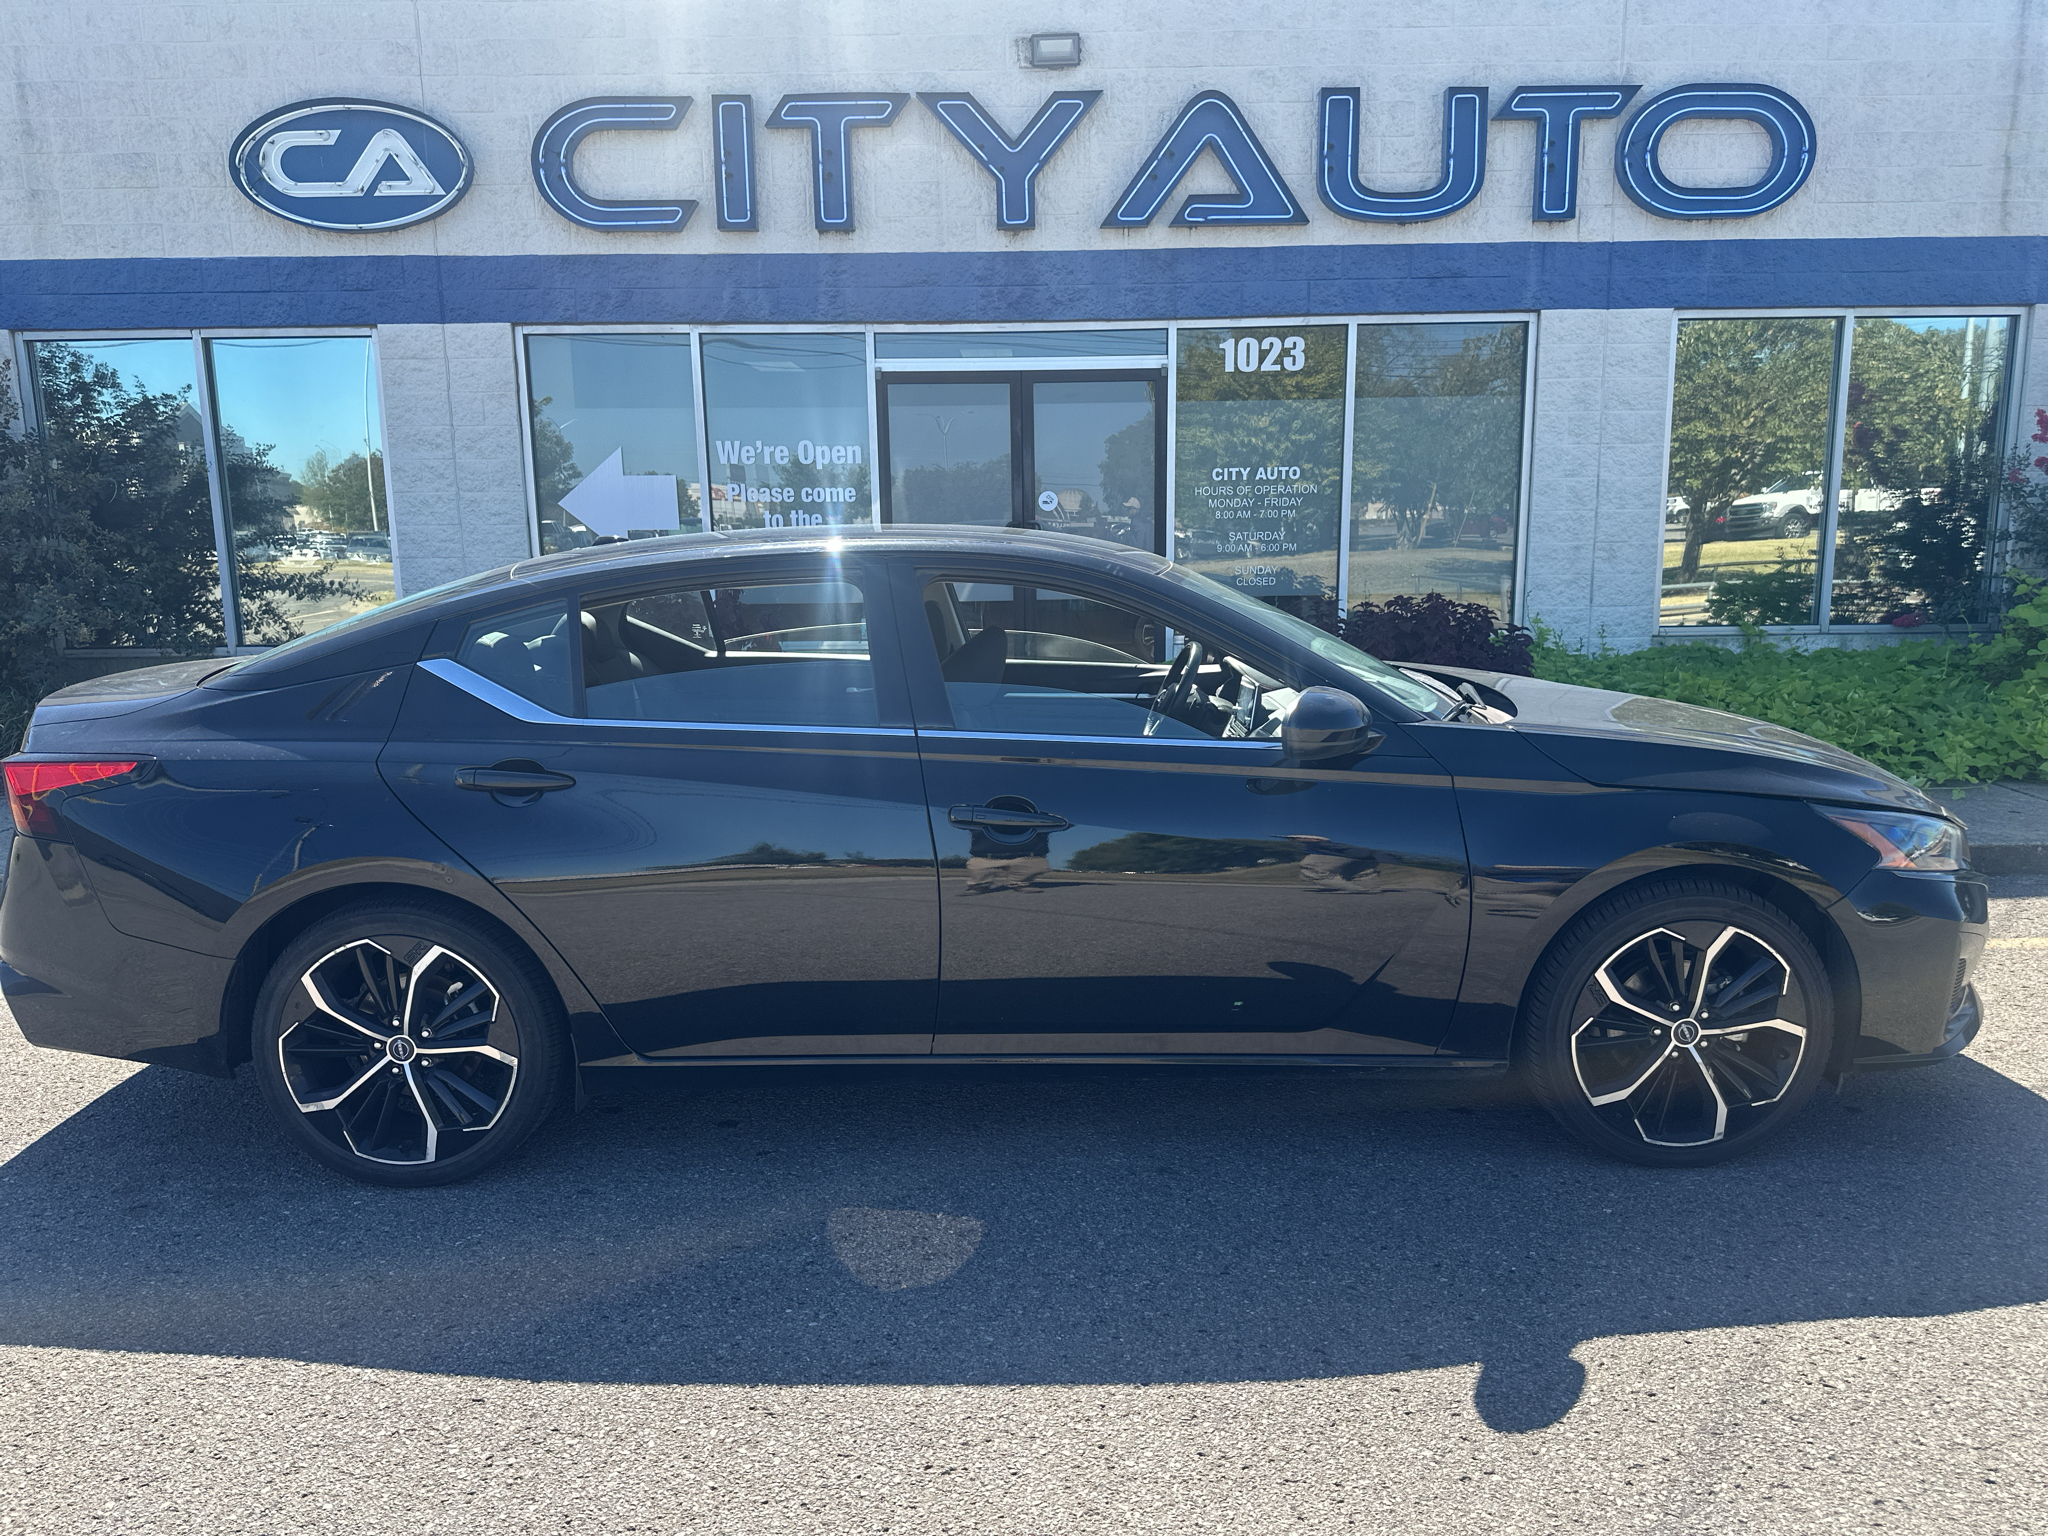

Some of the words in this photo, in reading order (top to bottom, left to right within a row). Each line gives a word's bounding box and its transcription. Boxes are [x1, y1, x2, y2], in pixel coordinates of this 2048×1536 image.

[260, 128, 446, 197] CA
[531, 90, 1104, 232] CITY
[1099, 83, 1817, 229] AUTO
[1219, 336, 1306, 373] 1023
[715, 440, 790, 465] We're
[797, 439, 862, 470] Open
[1212, 467, 1251, 481] CITY
[1255, 466, 1301, 480] AUTO
[727, 483, 795, 503] Please
[801, 486, 856, 503] come
[1195, 485, 1234, 496] HOURS
[1236, 485, 1252, 496] OF
[1254, 484, 1318, 495] OPERATION
[1208, 498, 1255, 508] MONDAY
[1264, 497, 1304, 507] FRIDAY
[763, 510, 784, 528] to
[789, 509, 823, 527] the
[1215, 510, 1235, 520] 8:00
[1236, 510, 1251, 519] AM
[1259, 510, 1279, 518] 7:00
[1281, 509, 1296, 518] PM
[1228, 531, 1286, 541] SATURDAY
[1216, 544, 1236, 553] 9:00
[1237, 543, 1253, 552] AM
[1260, 543, 1280, 552] 6:00
[1282, 543, 1297, 551] PM
[1234, 565, 1279, 575] SUNDAY
[1236, 576, 1276, 586] CLOSED
[403, 940, 428, 965] SR
